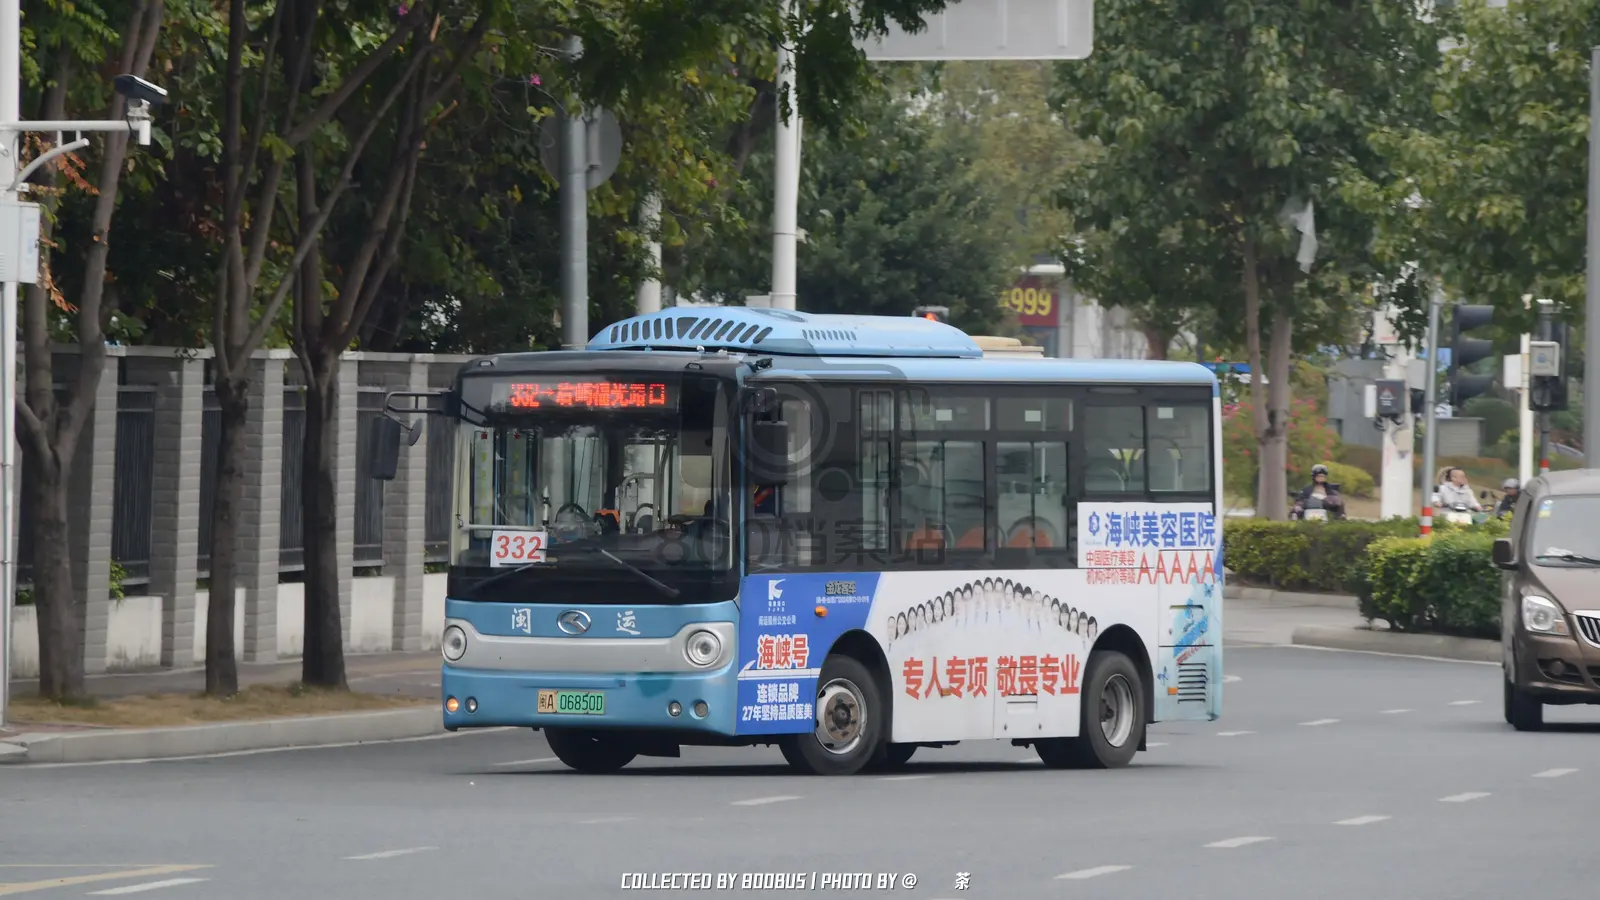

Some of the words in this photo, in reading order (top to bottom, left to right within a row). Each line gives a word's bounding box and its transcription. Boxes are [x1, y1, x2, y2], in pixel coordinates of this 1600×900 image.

[1104, 510, 1216, 548] 海峡美容医院
[495, 535, 542, 560] 332
[1086, 550, 1136, 567] 中国医疗美容
[511, 607, 532, 635] 闽
[615, 609, 641, 636] 运
[757, 634, 809, 669] 海峡号
[902, 656, 989, 700] 专人专项
[996, 654, 1081, 698] 敬畏专业
[757, 683, 799, 704] 连锁品牌
[742, 703, 813, 722] 27年坚持品质医美
